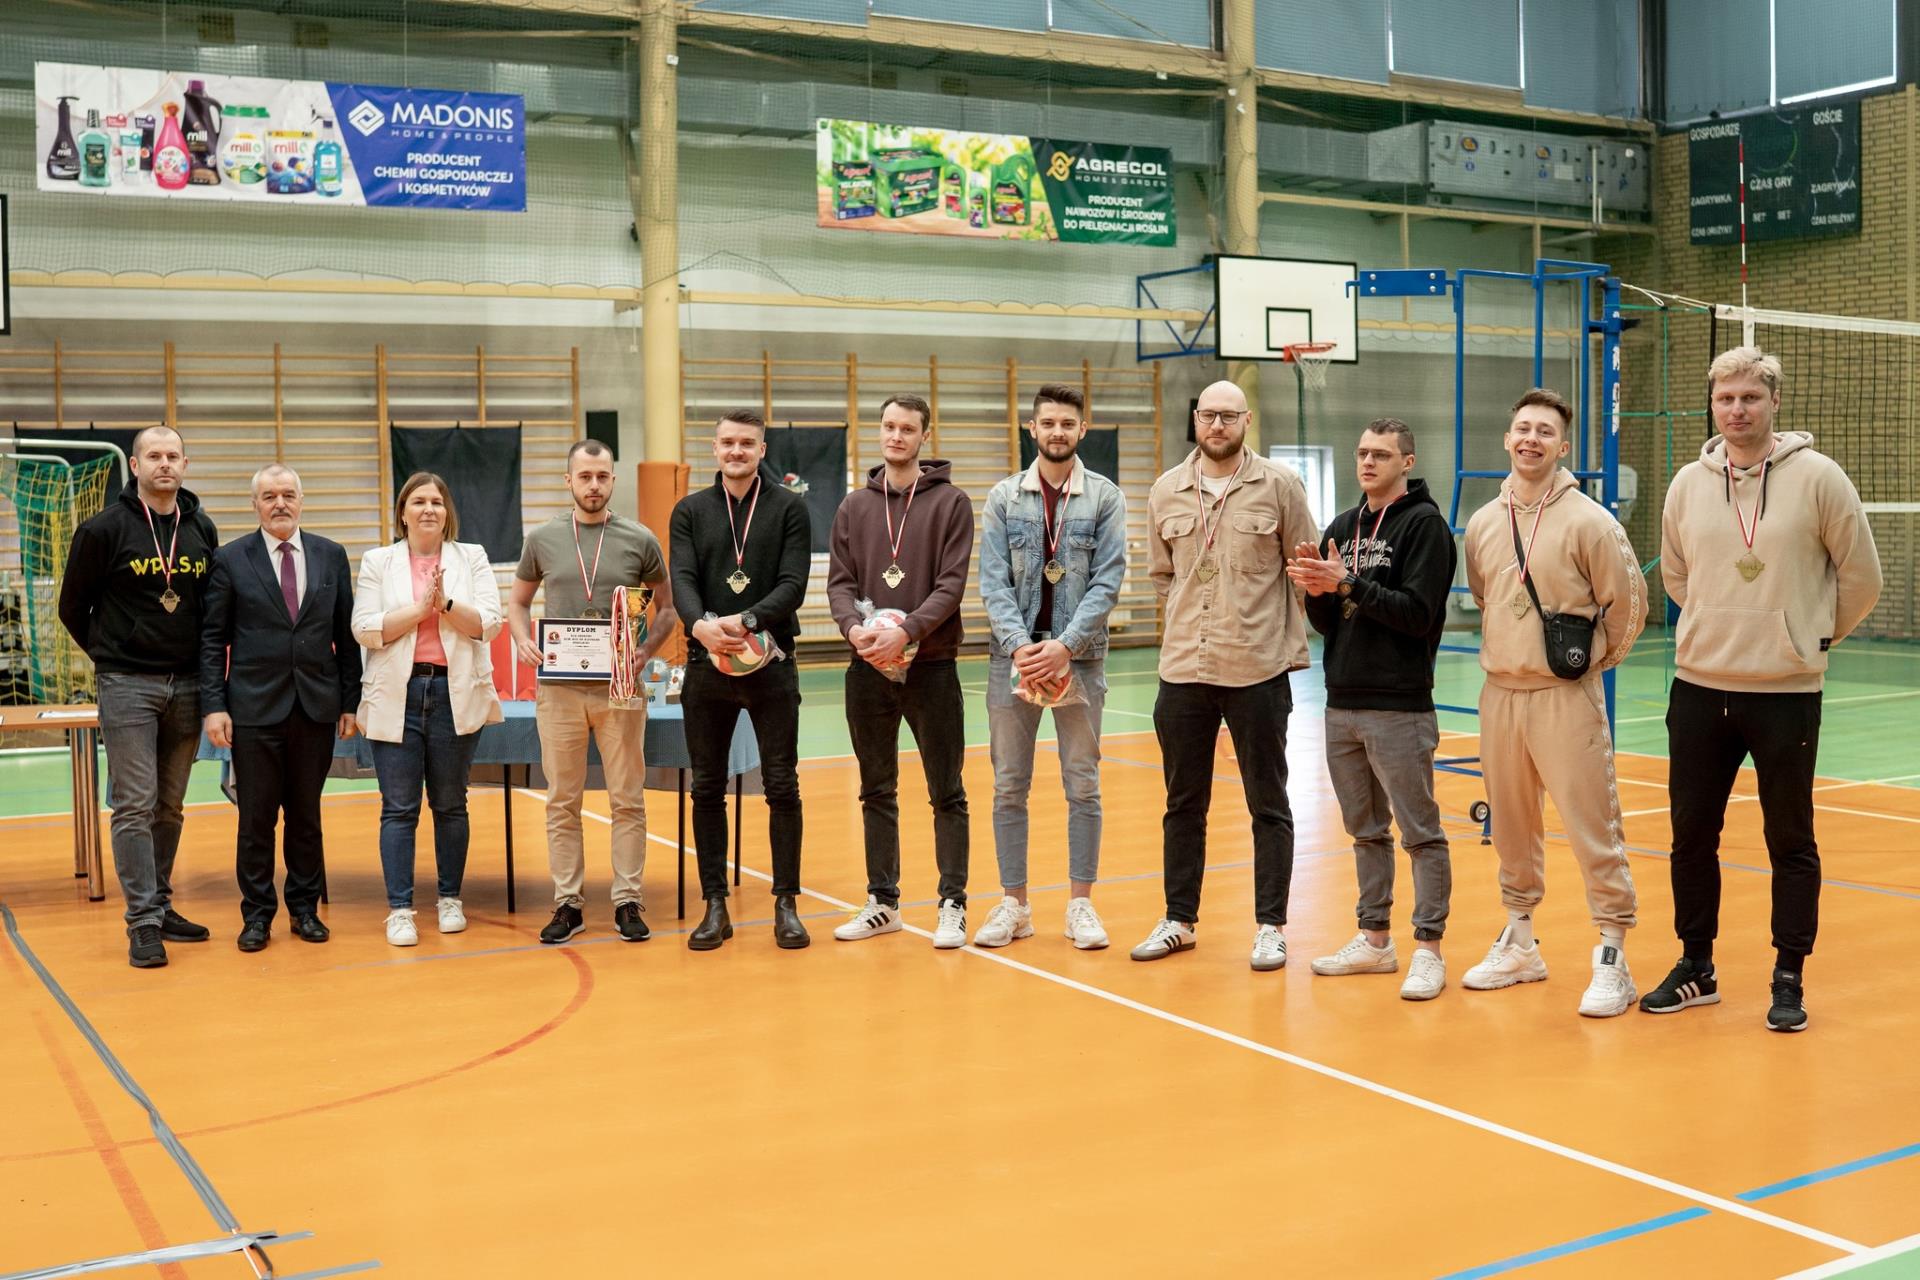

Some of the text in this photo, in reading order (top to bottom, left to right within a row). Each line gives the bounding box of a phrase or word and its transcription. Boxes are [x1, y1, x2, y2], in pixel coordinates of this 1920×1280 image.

[390, 102, 514, 130] MADONIS
[1813, 108, 1844, 125] GOŚCIE
[391, 130, 435, 139] HOME
[454, 132, 514, 143] PEOPLE
[1690, 123, 1740, 141] GOSPODARZE
[230, 142, 252, 153] mill
[274, 141, 298, 153] mill
[407, 152, 482, 166] PRODUCENT
[374, 166, 514, 183] CHEMII GOSPODARCZEJ
[1075, 158, 1167, 176] AGRECOL
[1075, 175, 1107, 183] HOME
[1121, 178, 1167, 187] GARDEN
[1749, 175, 1793, 191] CZAS GRY
[405, 181, 491, 197] KOSMETYKÓW
[1088, 195, 1143, 207] PRODUCENT
[1065, 206, 1115, 219] NAWOZÓW
[1121, 207, 1166, 221] ŚRODKÓW
[1063, 219, 1169, 234] DO PIELĘGNACJI ROŚLIN
[129, 556, 207, 578] WPLS.pl
